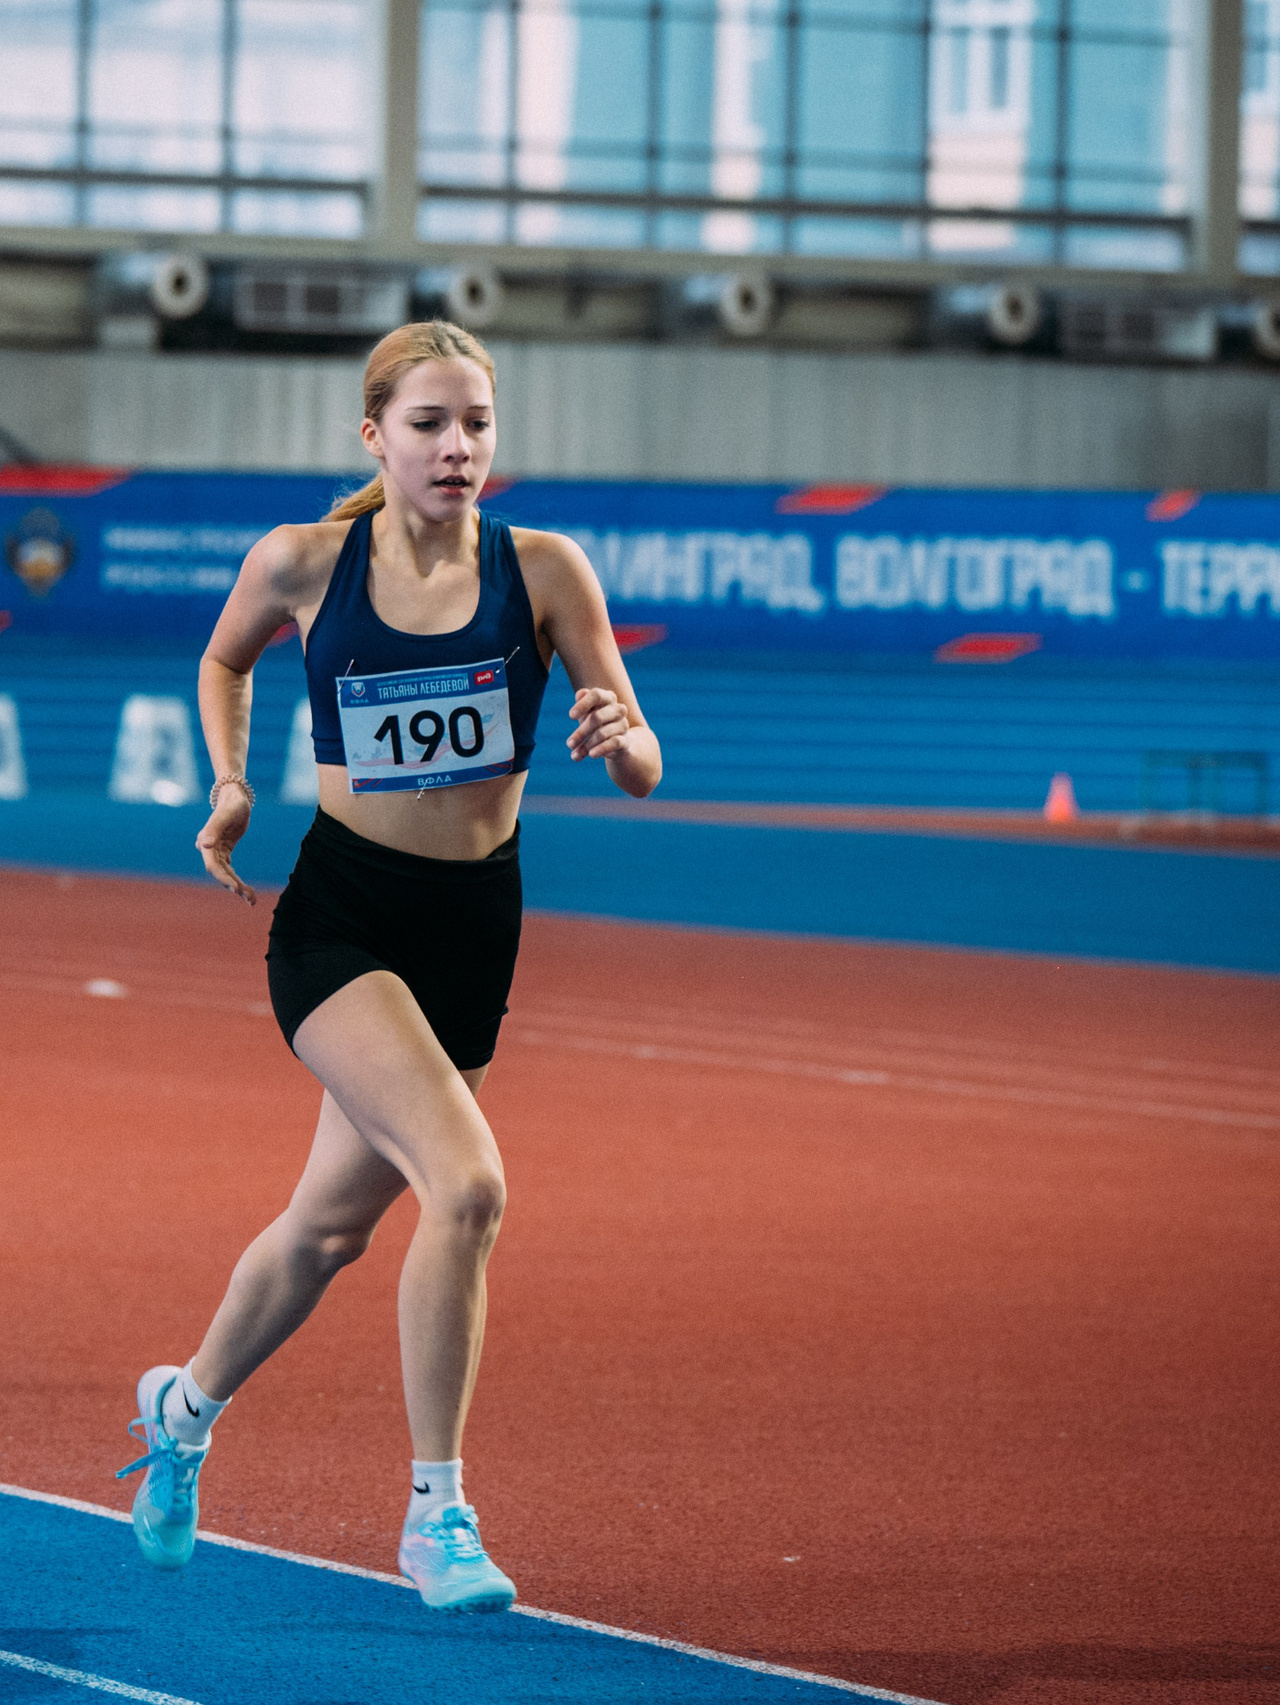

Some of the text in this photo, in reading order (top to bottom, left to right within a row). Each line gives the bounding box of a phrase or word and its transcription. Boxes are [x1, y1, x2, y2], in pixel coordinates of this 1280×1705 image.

[377, 683, 418, 699] ТАТЬЯНЫ
[420, 677, 469, 695] ЛЕБЕДЕВОЙ
[374, 706, 485, 765] 190
[417, 775, 452, 786] ВФЛА
